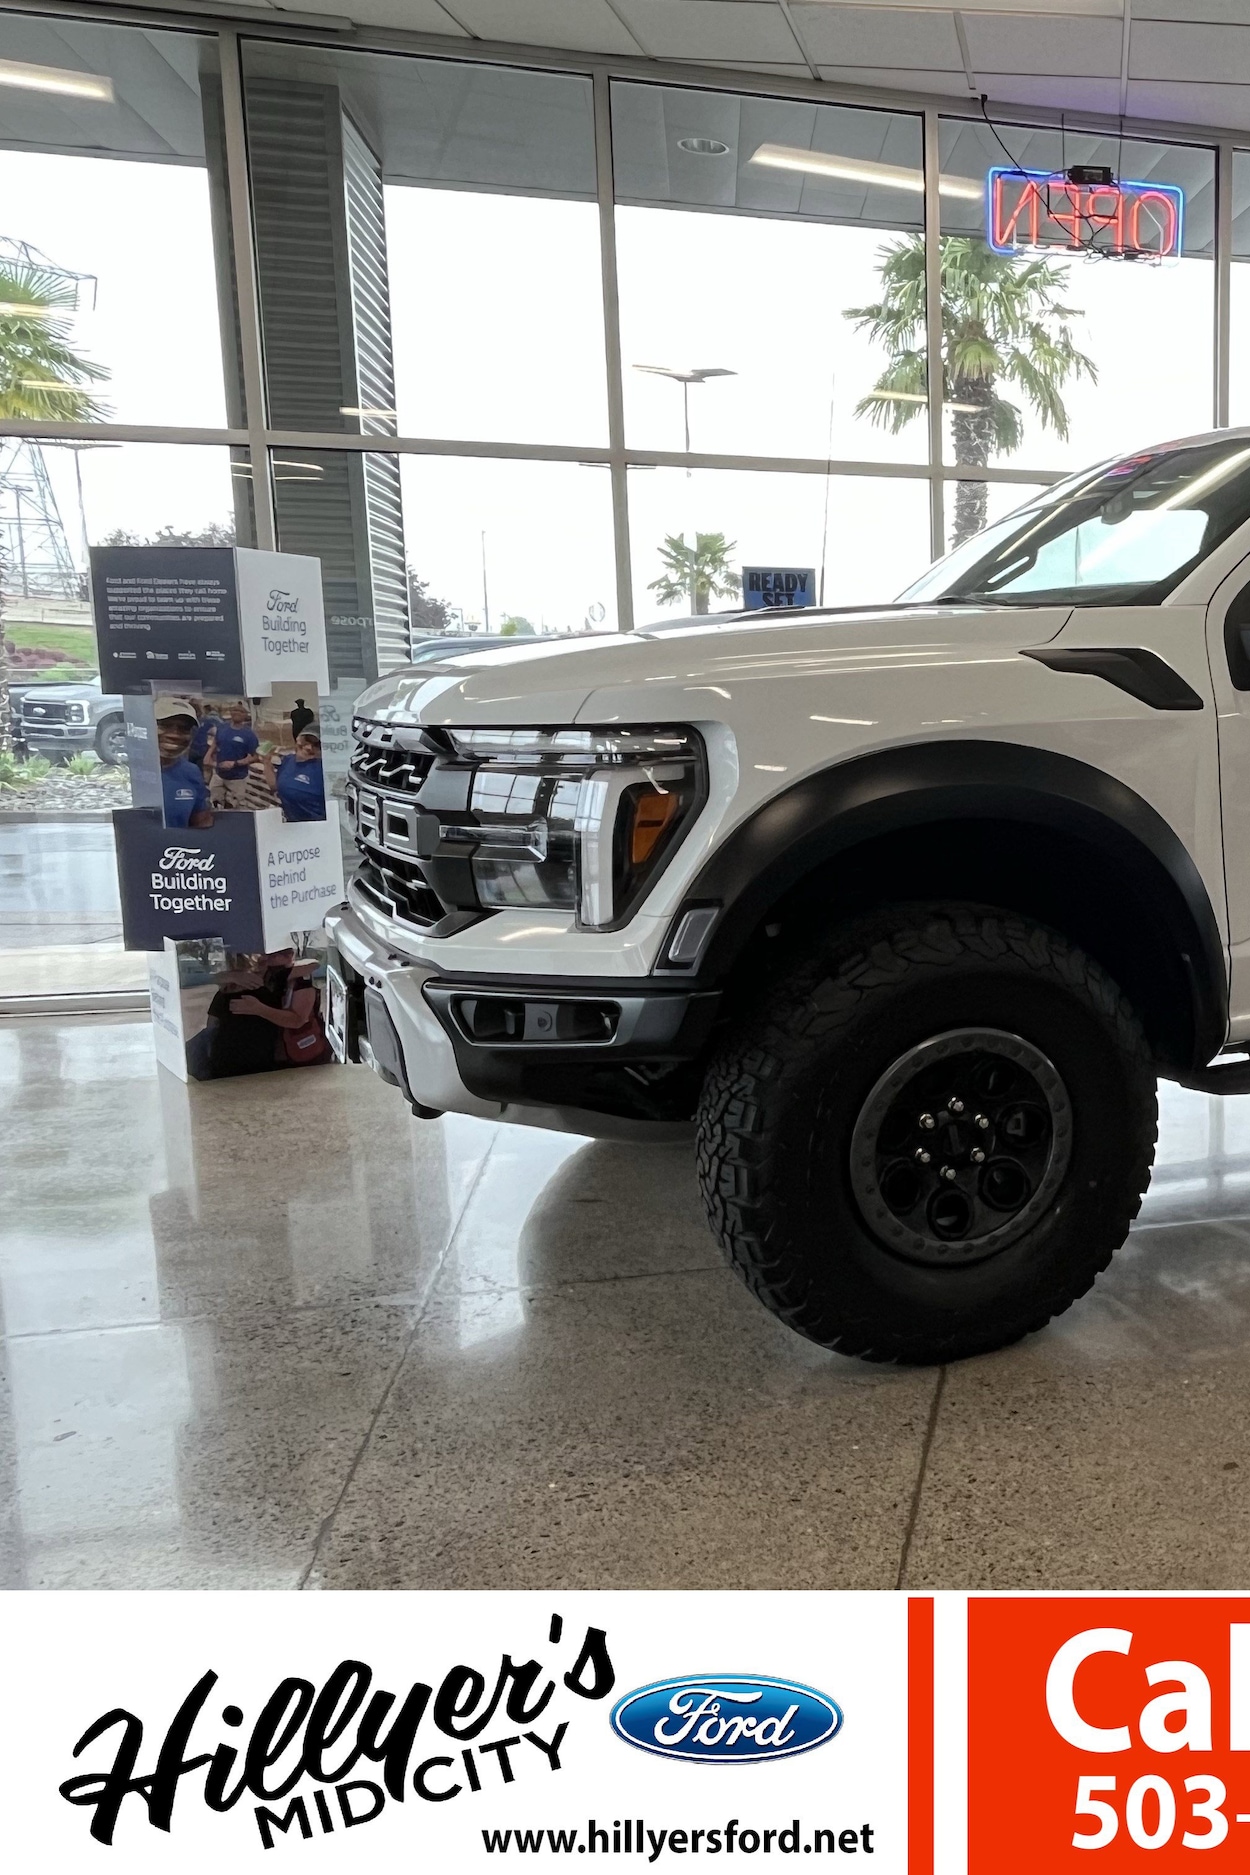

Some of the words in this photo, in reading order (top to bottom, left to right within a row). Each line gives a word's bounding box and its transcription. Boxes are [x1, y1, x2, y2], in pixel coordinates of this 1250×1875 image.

[748, 572, 808, 593] READY
[267, 589, 299, 613] Ford
[262, 615, 307, 636] Building
[261, 637, 309, 656] Together
[158, 846, 215, 872] Ford
[267, 852, 275, 866] A
[278, 845, 321, 868] Purpose
[151, 873, 227, 894] Building
[268, 867, 307, 888] Behind
[149, 894, 232, 913] Together
[270, 893, 289, 909] the
[291, 883, 337, 905] Purchase
